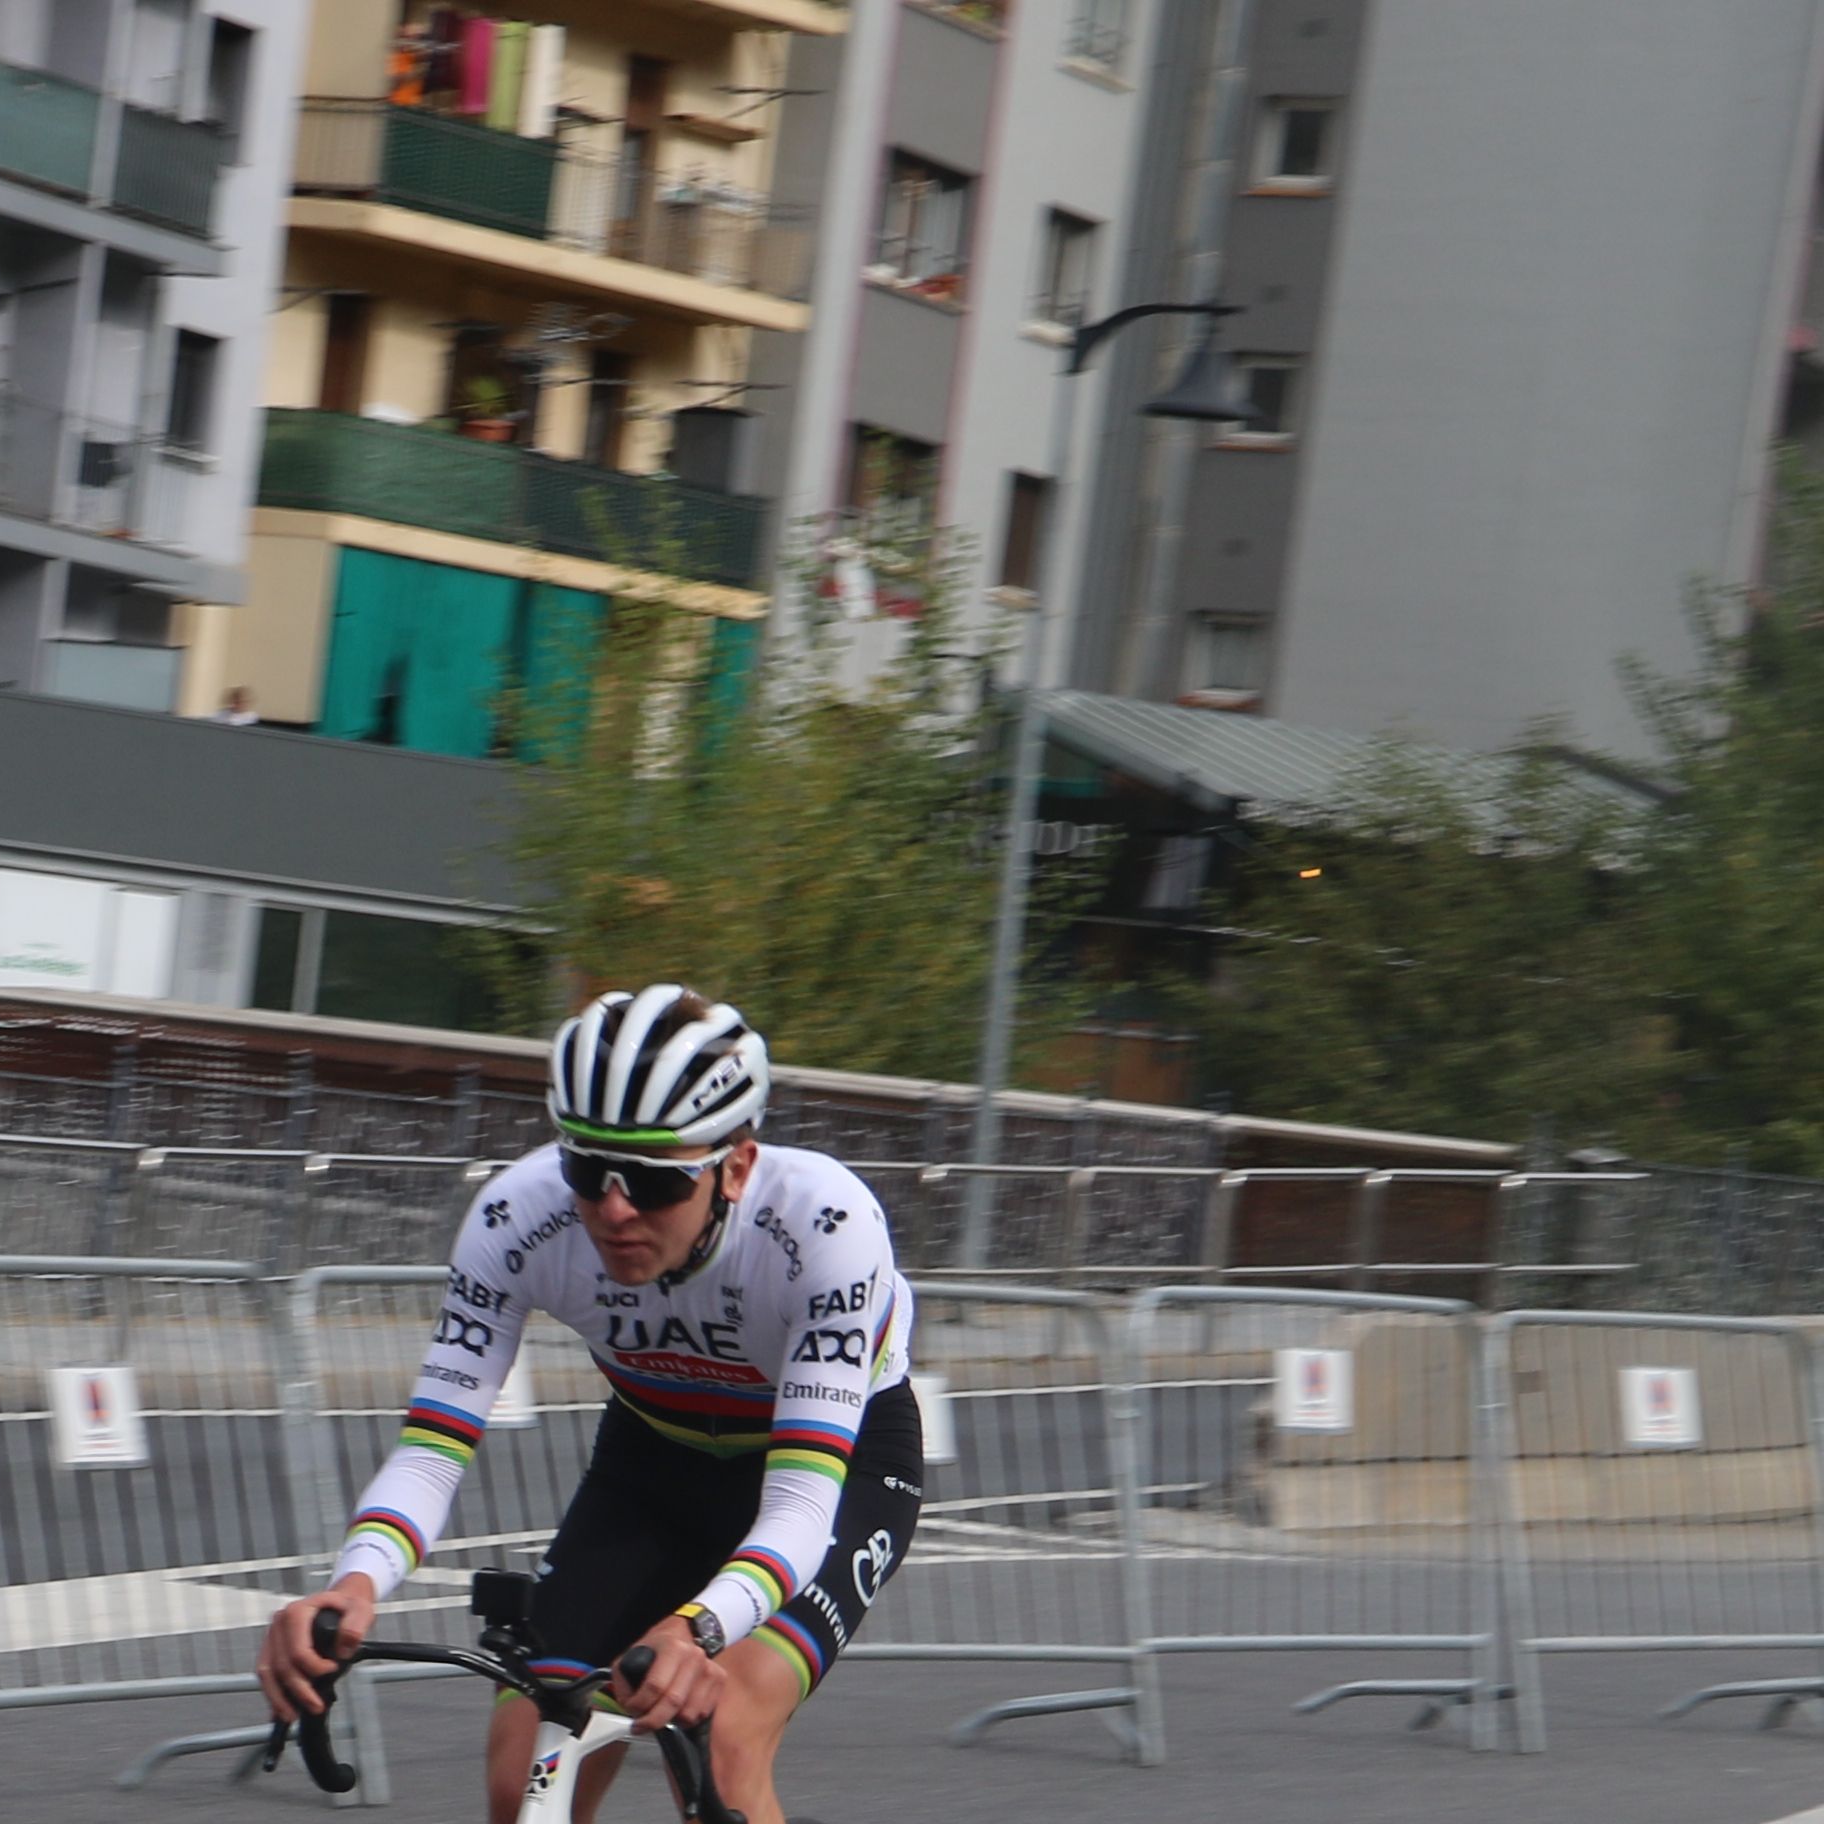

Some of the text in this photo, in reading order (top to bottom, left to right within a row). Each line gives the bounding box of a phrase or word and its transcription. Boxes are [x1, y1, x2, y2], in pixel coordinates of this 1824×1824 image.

[693, 1055, 743, 1112] MET
[604, 1293, 639, 1307] UCI
[606, 1315, 749, 1362] UAE
[790, 1328, 866, 1369] ADQ
[783, 1381, 863, 1409] Emirates
